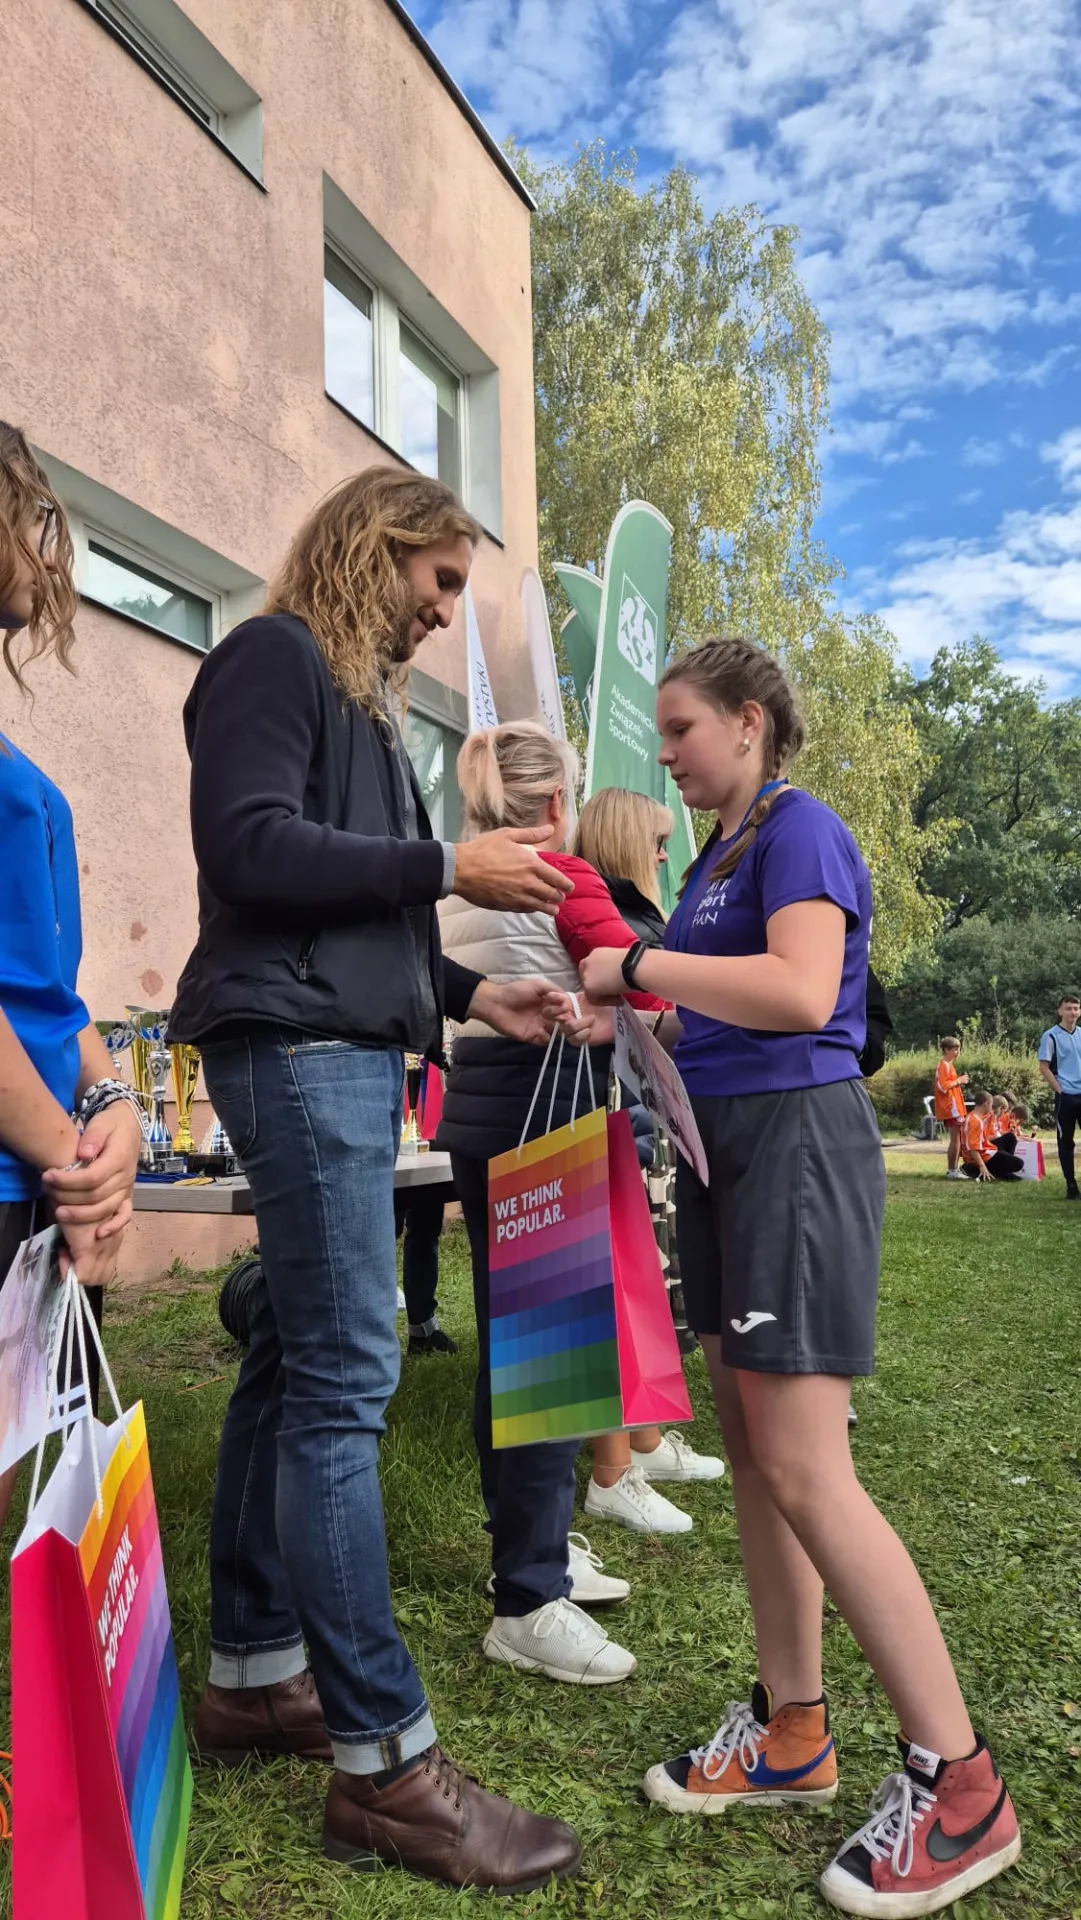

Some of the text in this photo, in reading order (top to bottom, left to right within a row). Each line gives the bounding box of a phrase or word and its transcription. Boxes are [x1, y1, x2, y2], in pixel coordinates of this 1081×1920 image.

[608, 718, 649, 762] Sportowy
[226, 1158, 234, 1173] 2
[494, 1177, 563, 1221] WE THINK
[496, 1203, 566, 1244] POPULAR.
[98, 1522, 133, 1647] WE THINK
[104, 1563, 139, 1688] POPULAR.
